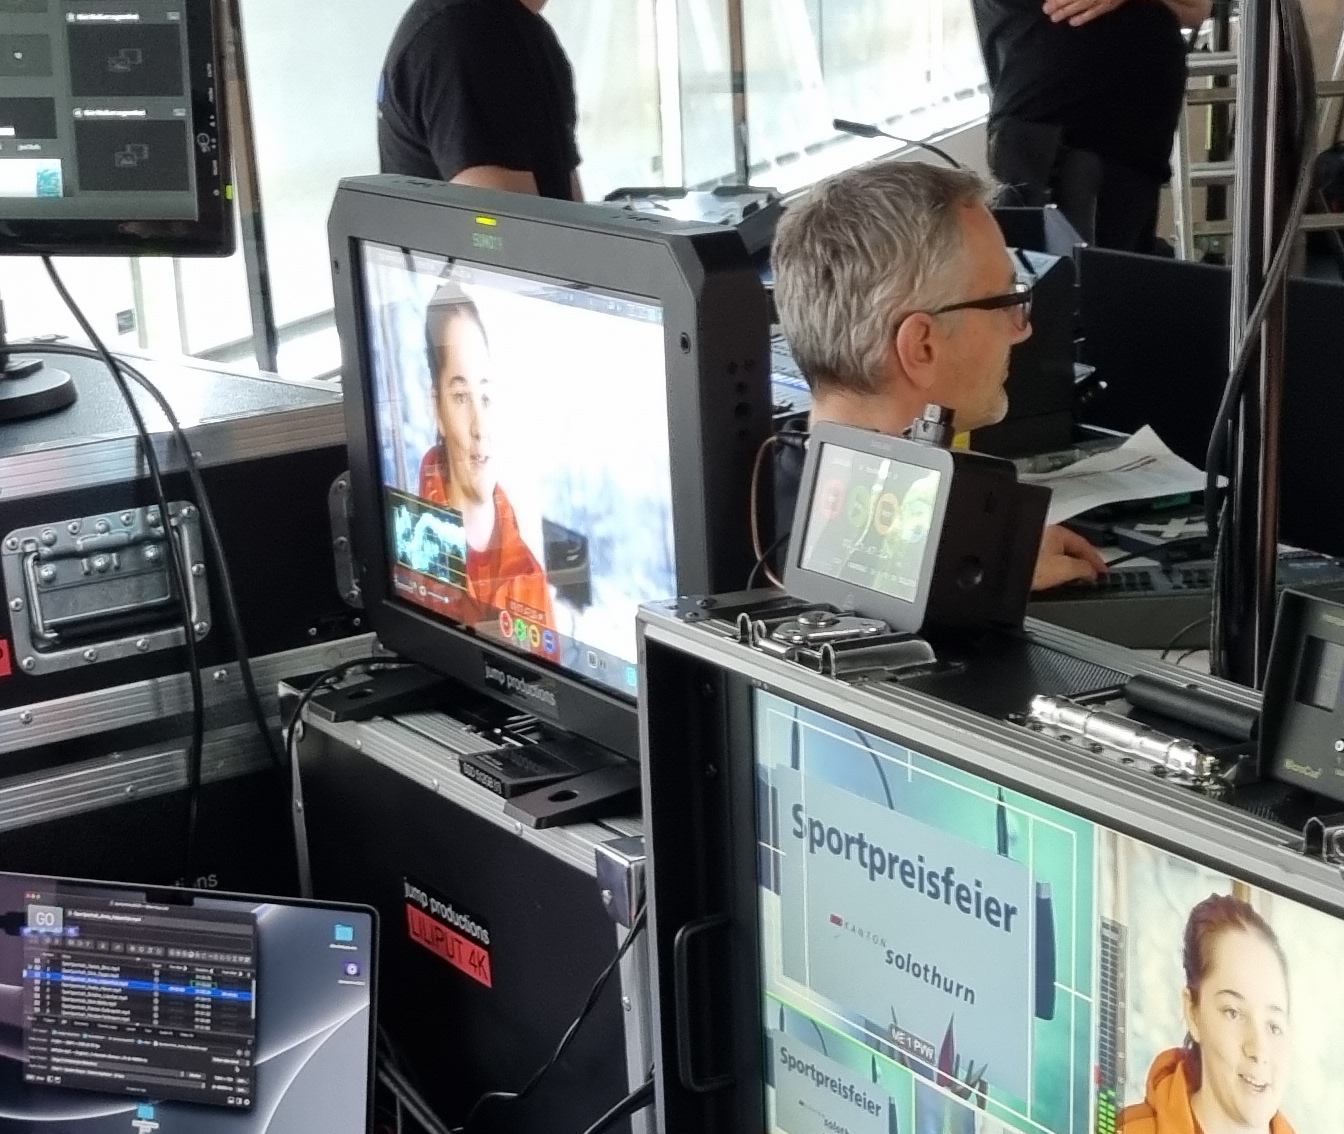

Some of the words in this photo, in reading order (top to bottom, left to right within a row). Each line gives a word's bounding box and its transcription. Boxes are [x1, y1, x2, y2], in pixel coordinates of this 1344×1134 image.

[485, 661, 506, 687] jump
[507, 674, 556, 706] productions
[792, 803, 1018, 933] Sportpreisfeier
[35, 911, 55, 928] GO
[403, 876, 428, 908] jump
[430, 898, 490, 944] productions
[469, 949, 488, 980] 4K
[885, 947, 976, 1005] solothurn
[780, 1046, 882, 1118] Sportpreisfeier
